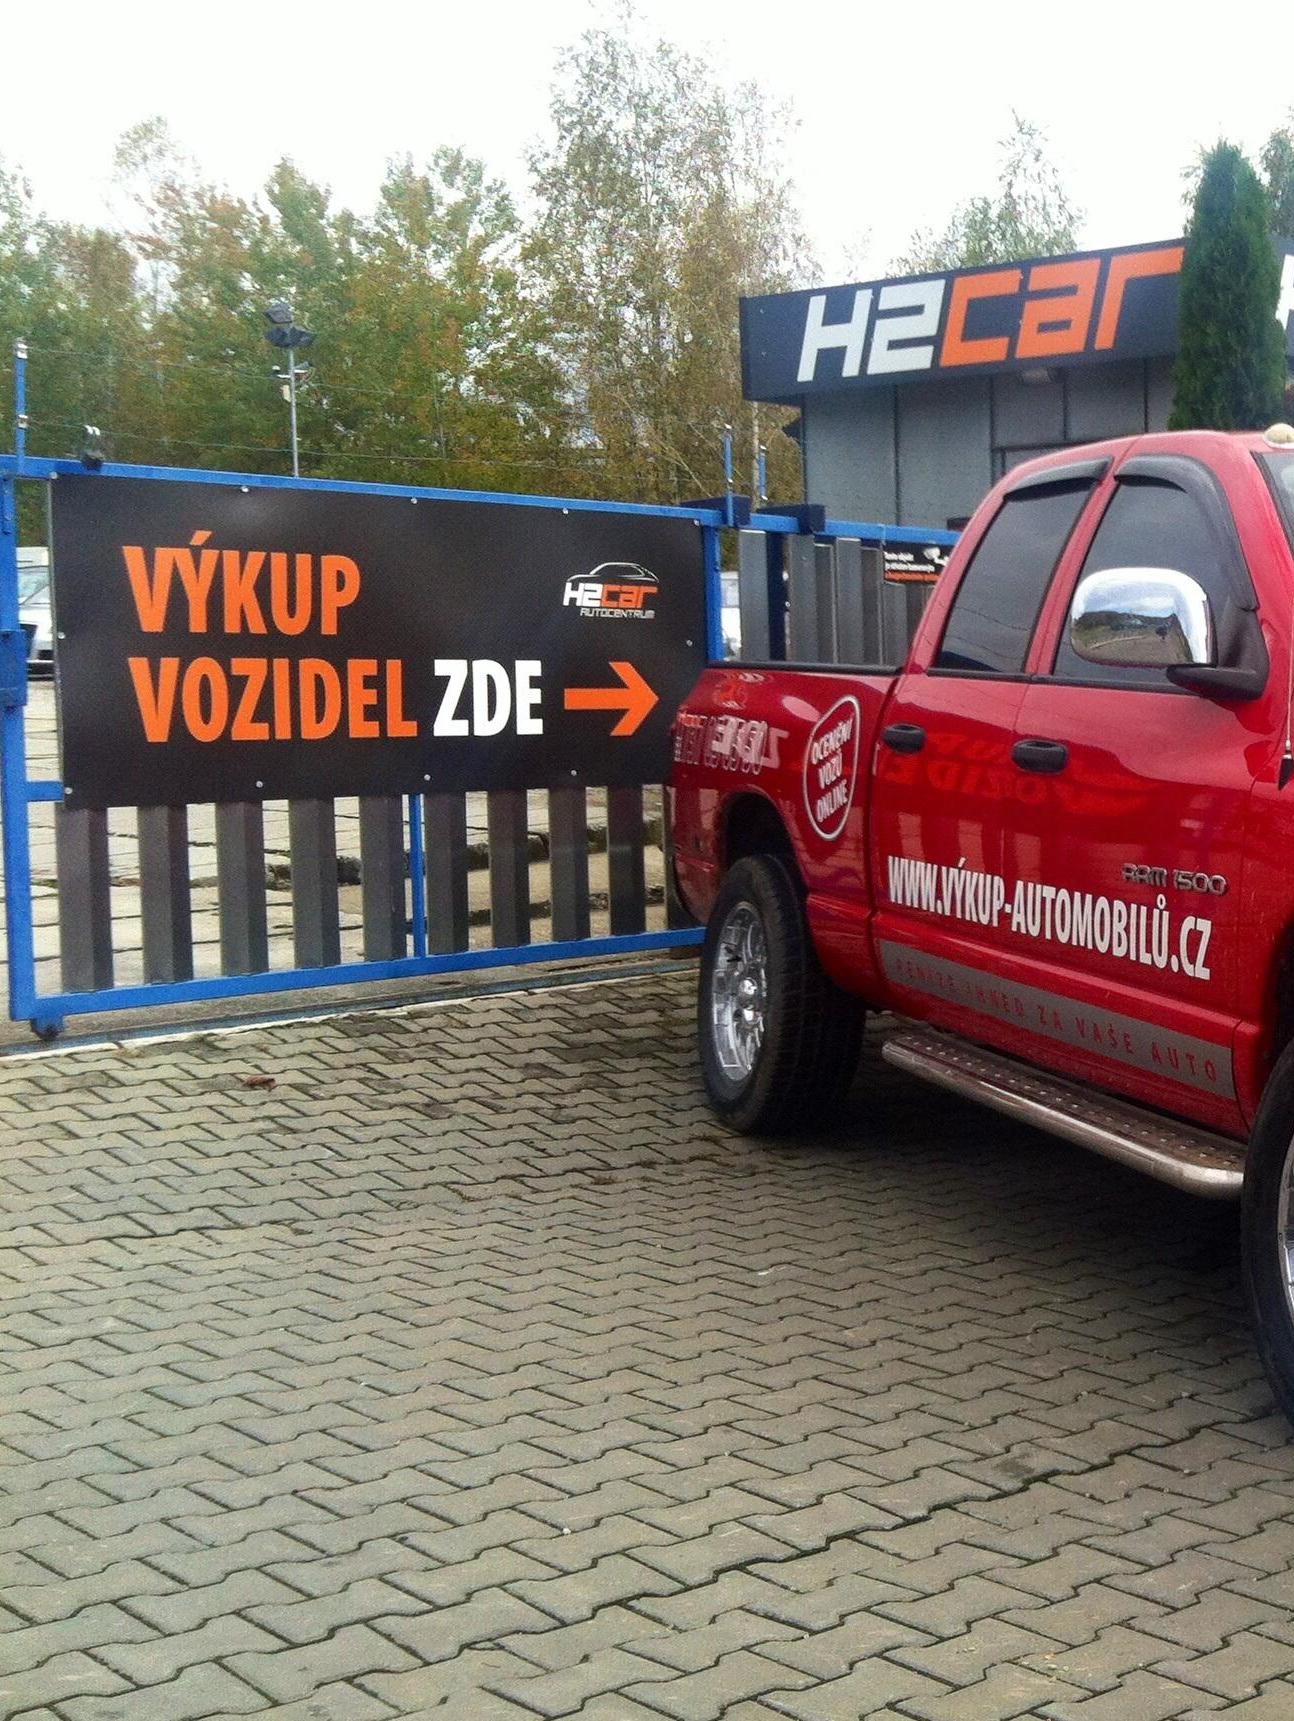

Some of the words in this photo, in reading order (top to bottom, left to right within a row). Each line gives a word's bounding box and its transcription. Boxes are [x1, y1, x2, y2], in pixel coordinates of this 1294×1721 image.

[122, 530, 361, 635] VÝKUP
[128, 656, 418, 742] VOZIDEL
[432, 659, 544, 738] ZDE
[816, 779, 848, 822] ONLINE
[1173, 869, 1228, 896] 1500
[887, 856, 1213, 981] WWW.VÝKUP-AUTOMOBILŮ.CZ
[1151, 1040, 1218, 1083] AUTO
